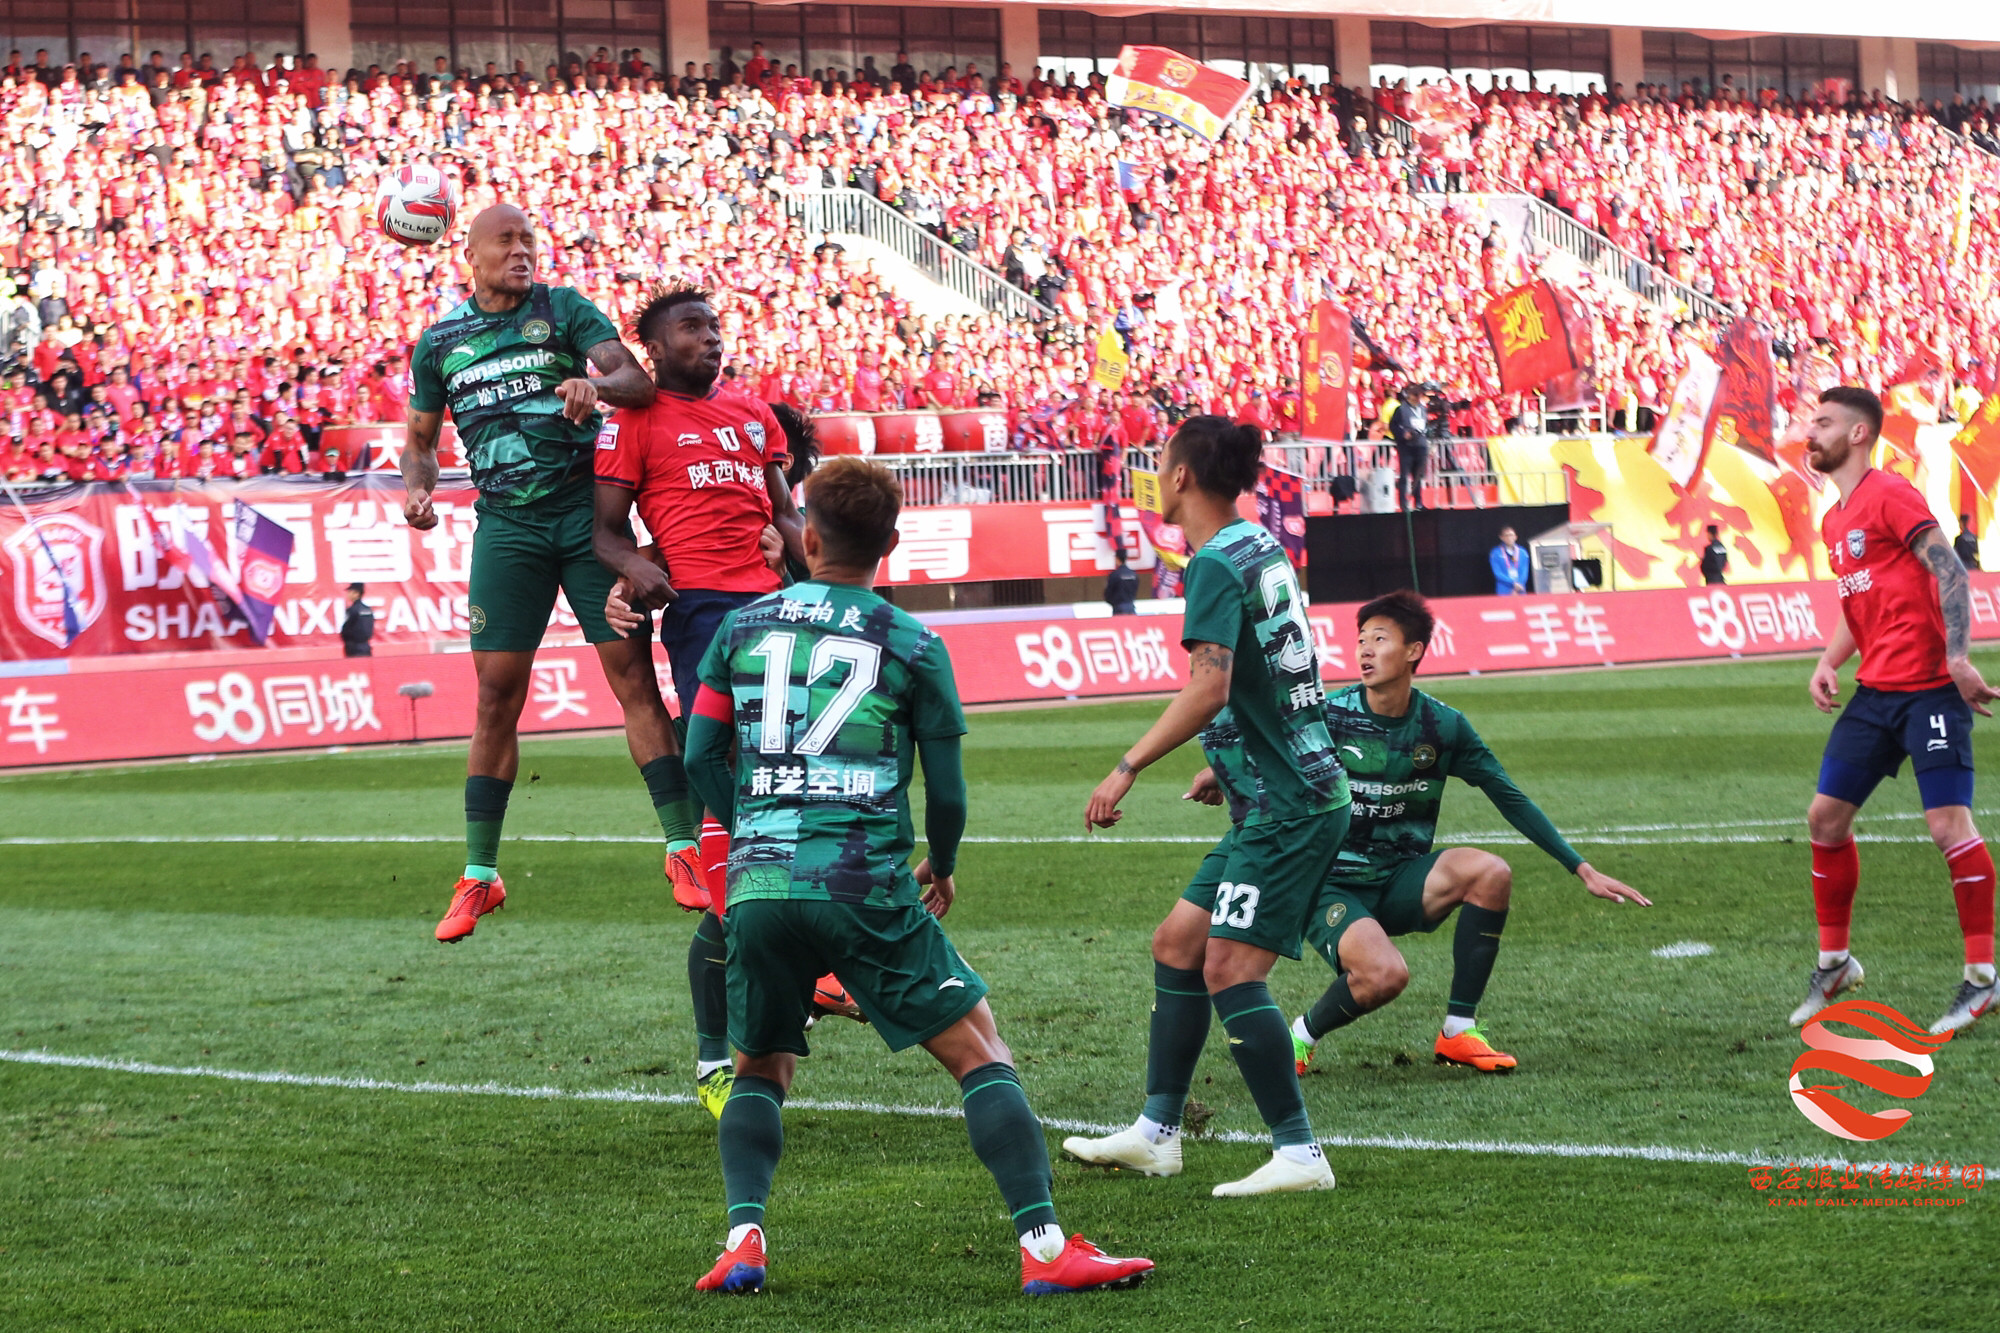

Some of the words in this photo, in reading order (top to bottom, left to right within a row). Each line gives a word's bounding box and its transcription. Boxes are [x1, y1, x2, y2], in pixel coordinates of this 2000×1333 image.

[394, 218, 432, 234] KELME
[451, 348, 556, 390] Panasonic
[477, 374, 542, 406] 松下卫浴
[712, 426, 741, 452] 10
[687, 461, 765, 490] 陕西体彩
[777, 598, 865, 632] 陈柏良
[1480, 601, 1616, 658] 二手车
[1687, 589, 1823, 650] 58同城
[1, 687, 68, 753] 车
[184, 672, 382, 745] 58同城
[1015, 624, 1178, 691] 58同城
[748, 631, 883, 757] 17
[1929, 713, 1947, 738] 4
[1348, 779, 1429, 796] anasonic
[1210, 882, 1260, 930] 33
